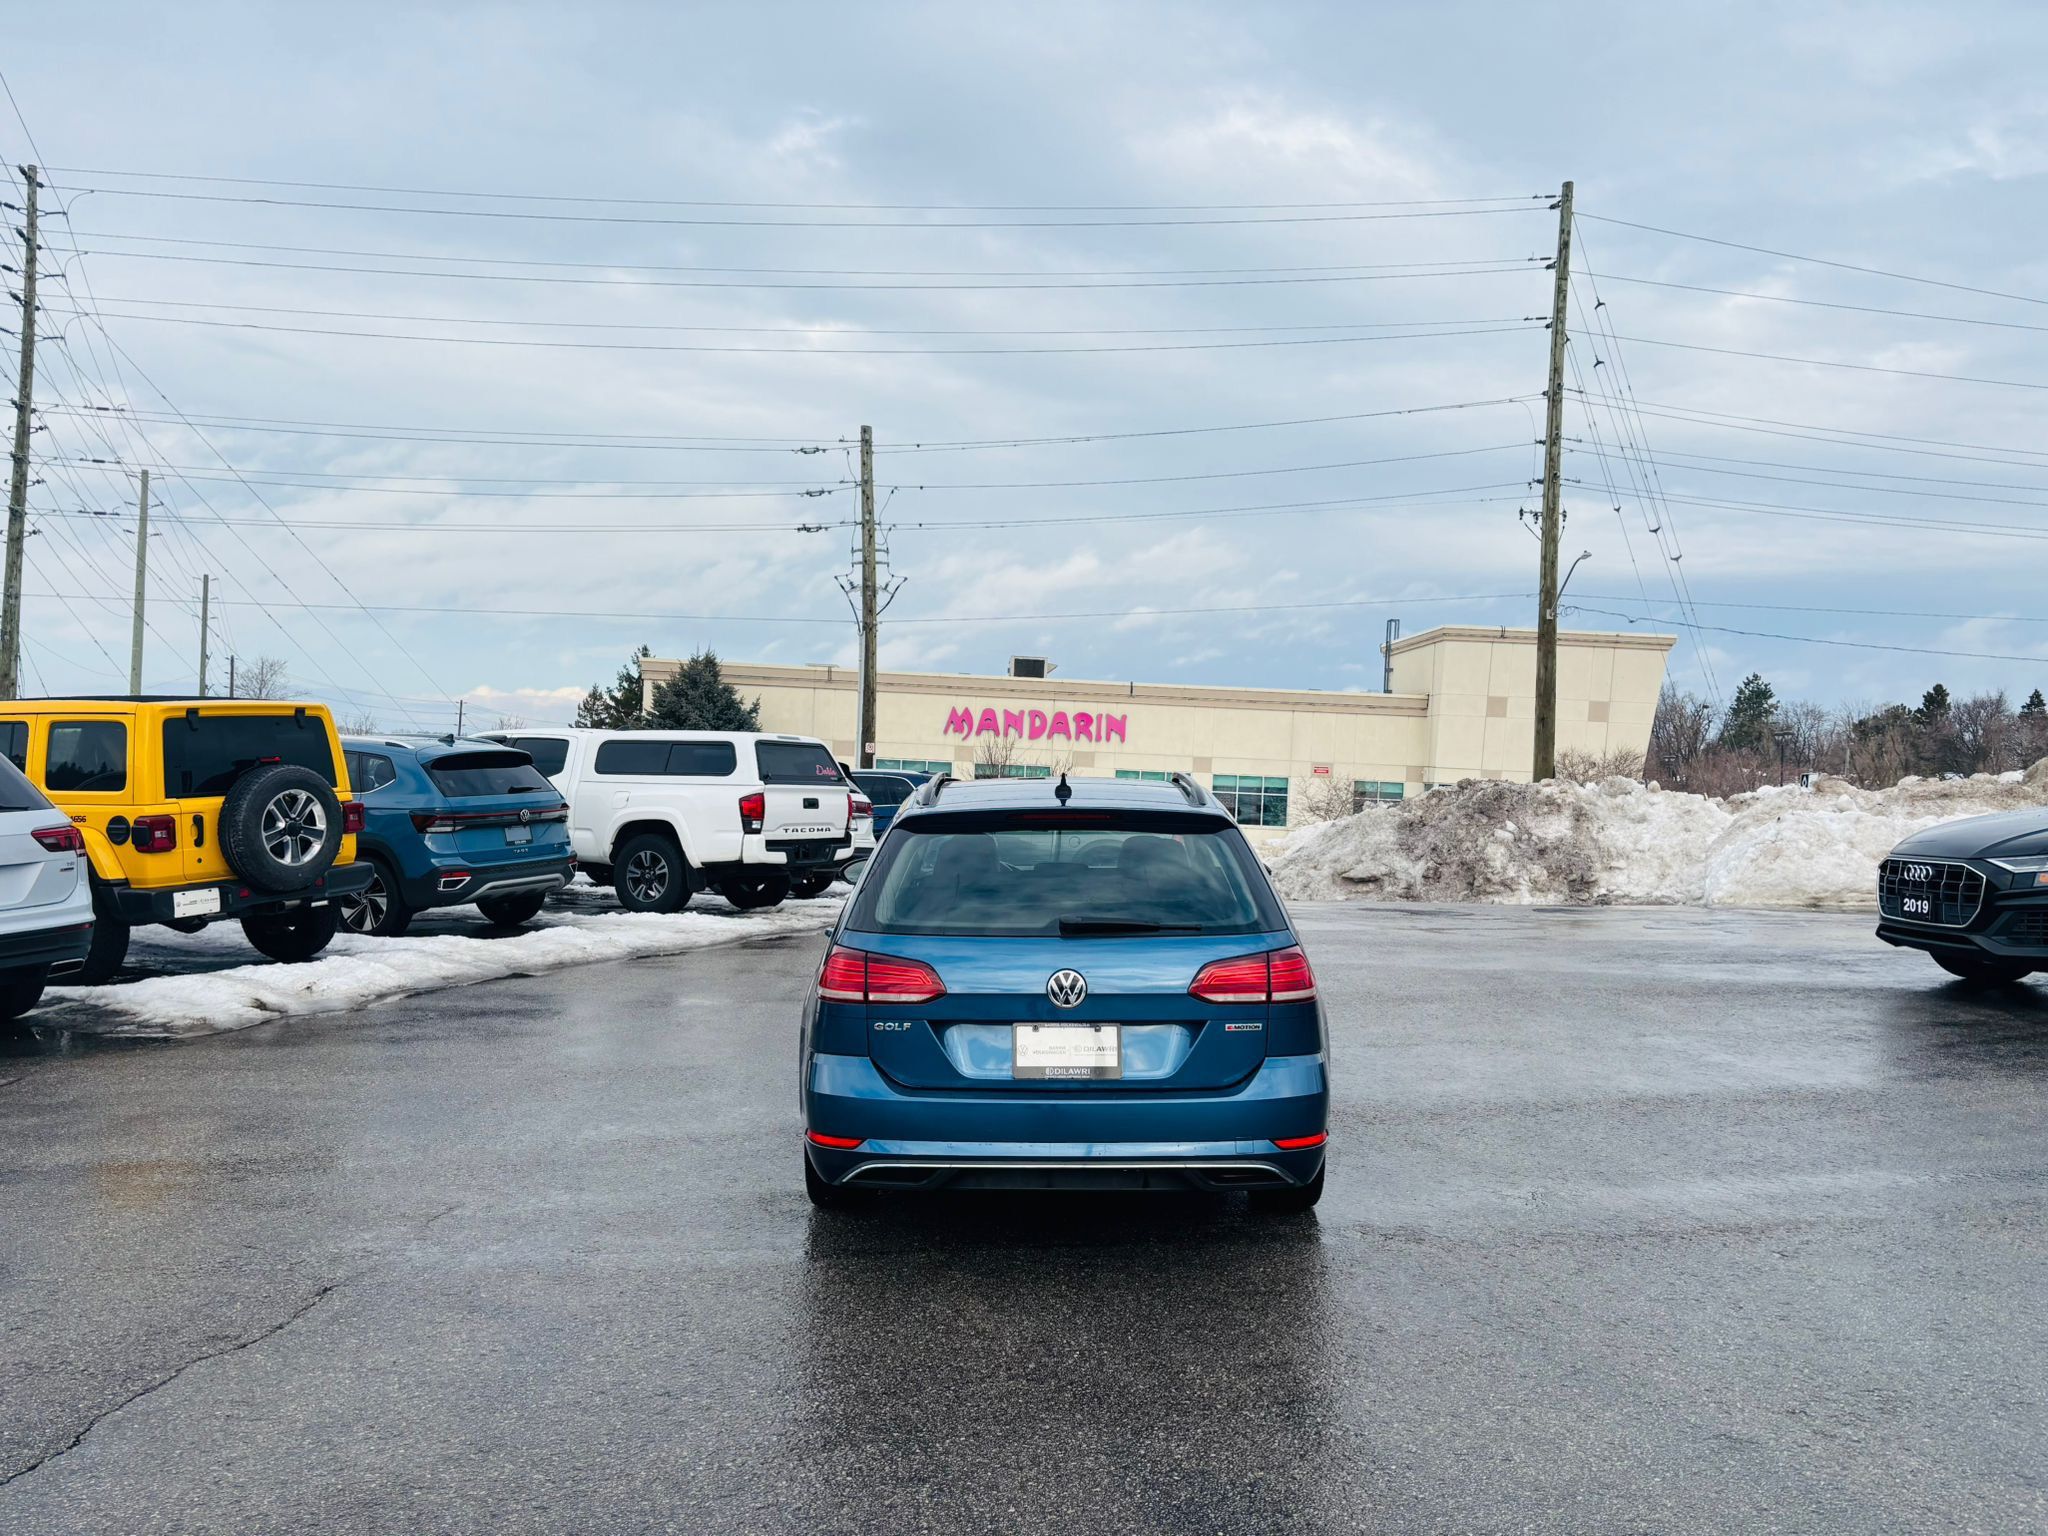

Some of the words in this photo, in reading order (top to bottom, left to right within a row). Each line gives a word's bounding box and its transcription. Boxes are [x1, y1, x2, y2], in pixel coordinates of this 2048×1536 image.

[943, 706, 1128, 744] MANDARIN
[1903, 897, 1929, 914] 2019
[873, 1022, 912, 1031] GOLF
[1054, 1067, 1091, 1075] DILAWRI
